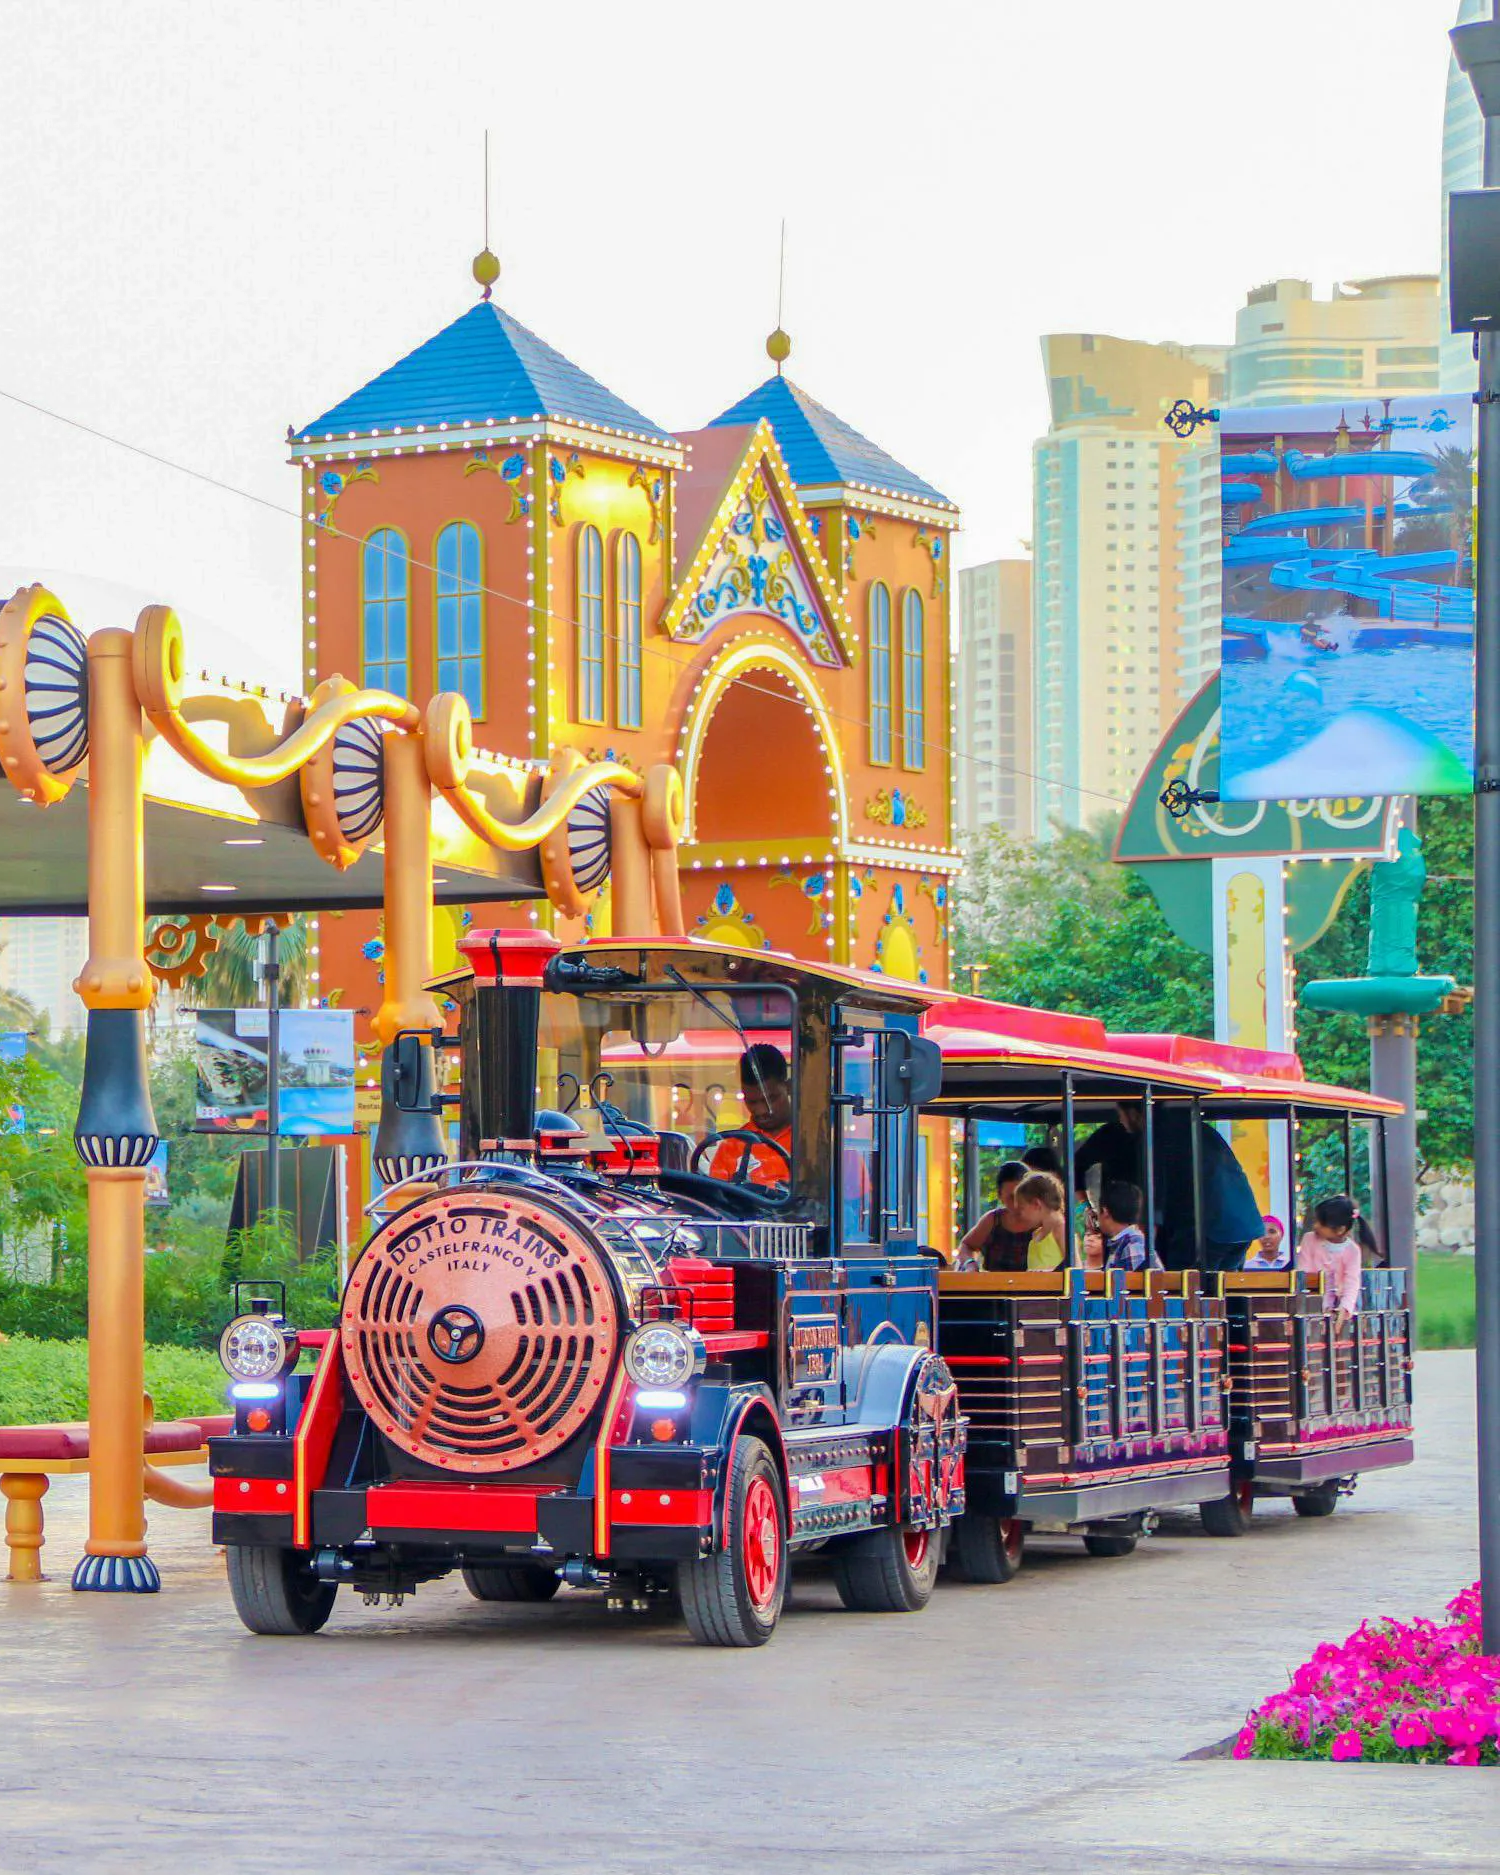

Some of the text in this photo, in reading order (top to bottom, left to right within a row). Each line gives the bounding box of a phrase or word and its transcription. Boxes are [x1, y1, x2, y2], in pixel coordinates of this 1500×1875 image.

[390, 1217, 561, 1268] DOTTO TRAINS
[408, 1241, 524, 1275] CASTELFRANCO
[447, 1259, 491, 1272] ITALY
